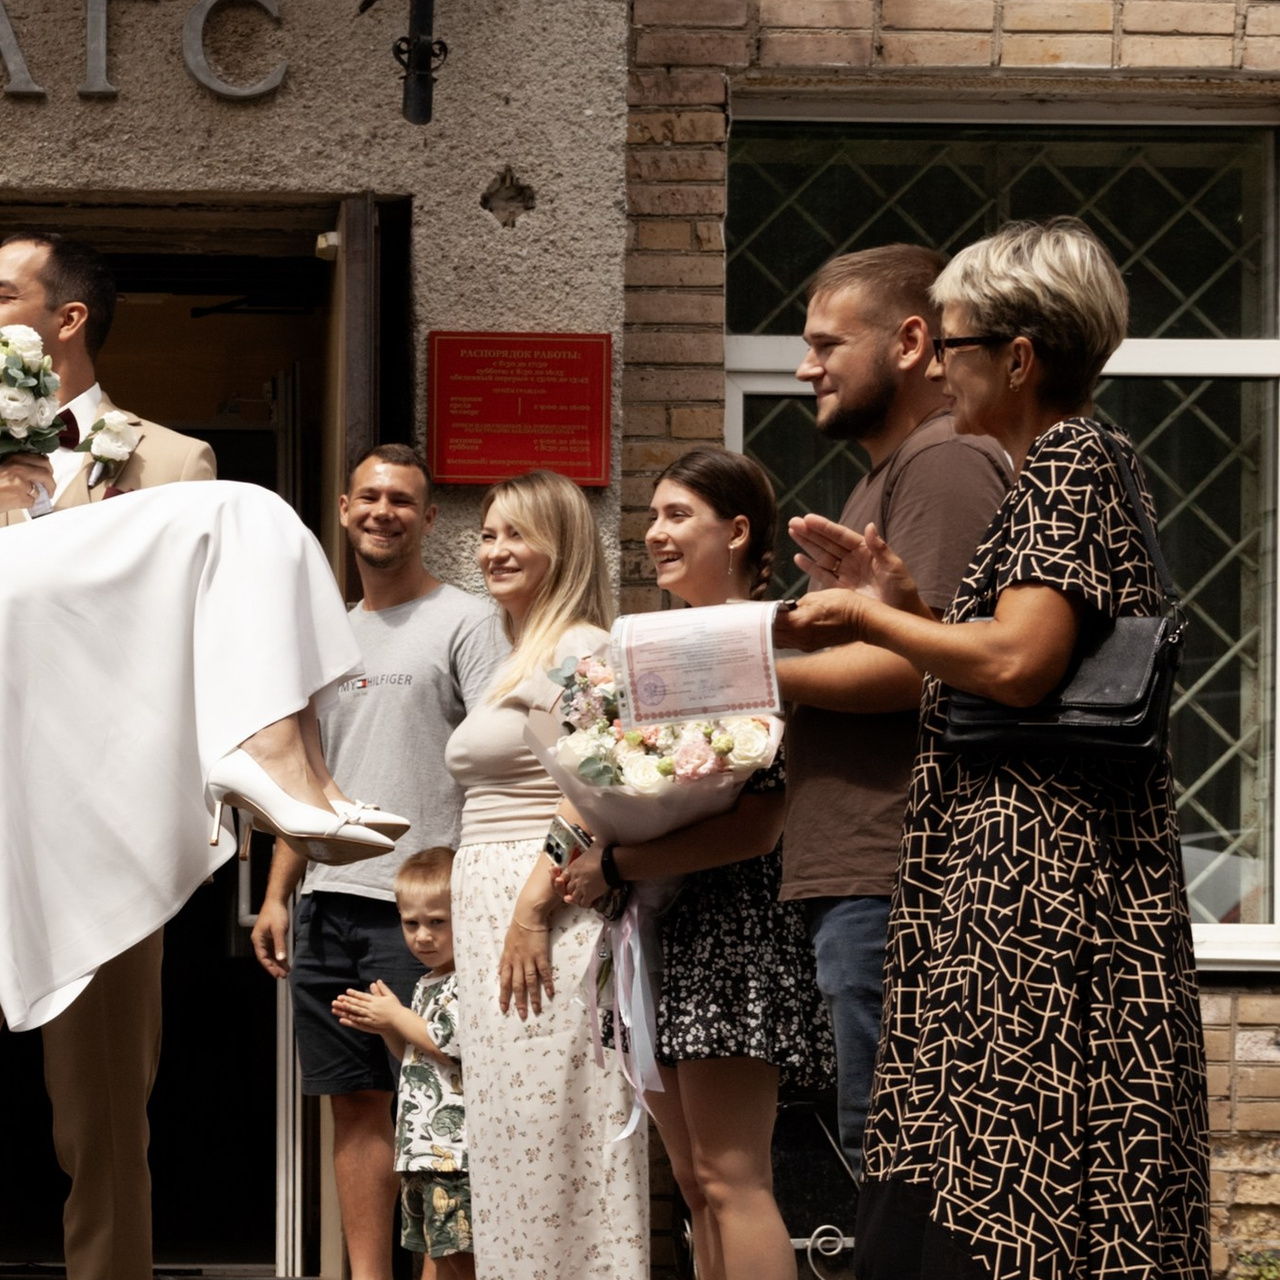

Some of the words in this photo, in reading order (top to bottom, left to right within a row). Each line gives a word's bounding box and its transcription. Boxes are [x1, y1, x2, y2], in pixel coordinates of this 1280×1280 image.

[460, 349, 532, 358] РАСПОРЯДОК
[533, 350, 581, 360] РАБОТЫ:
[367, 673, 413, 687] HILFIGER
